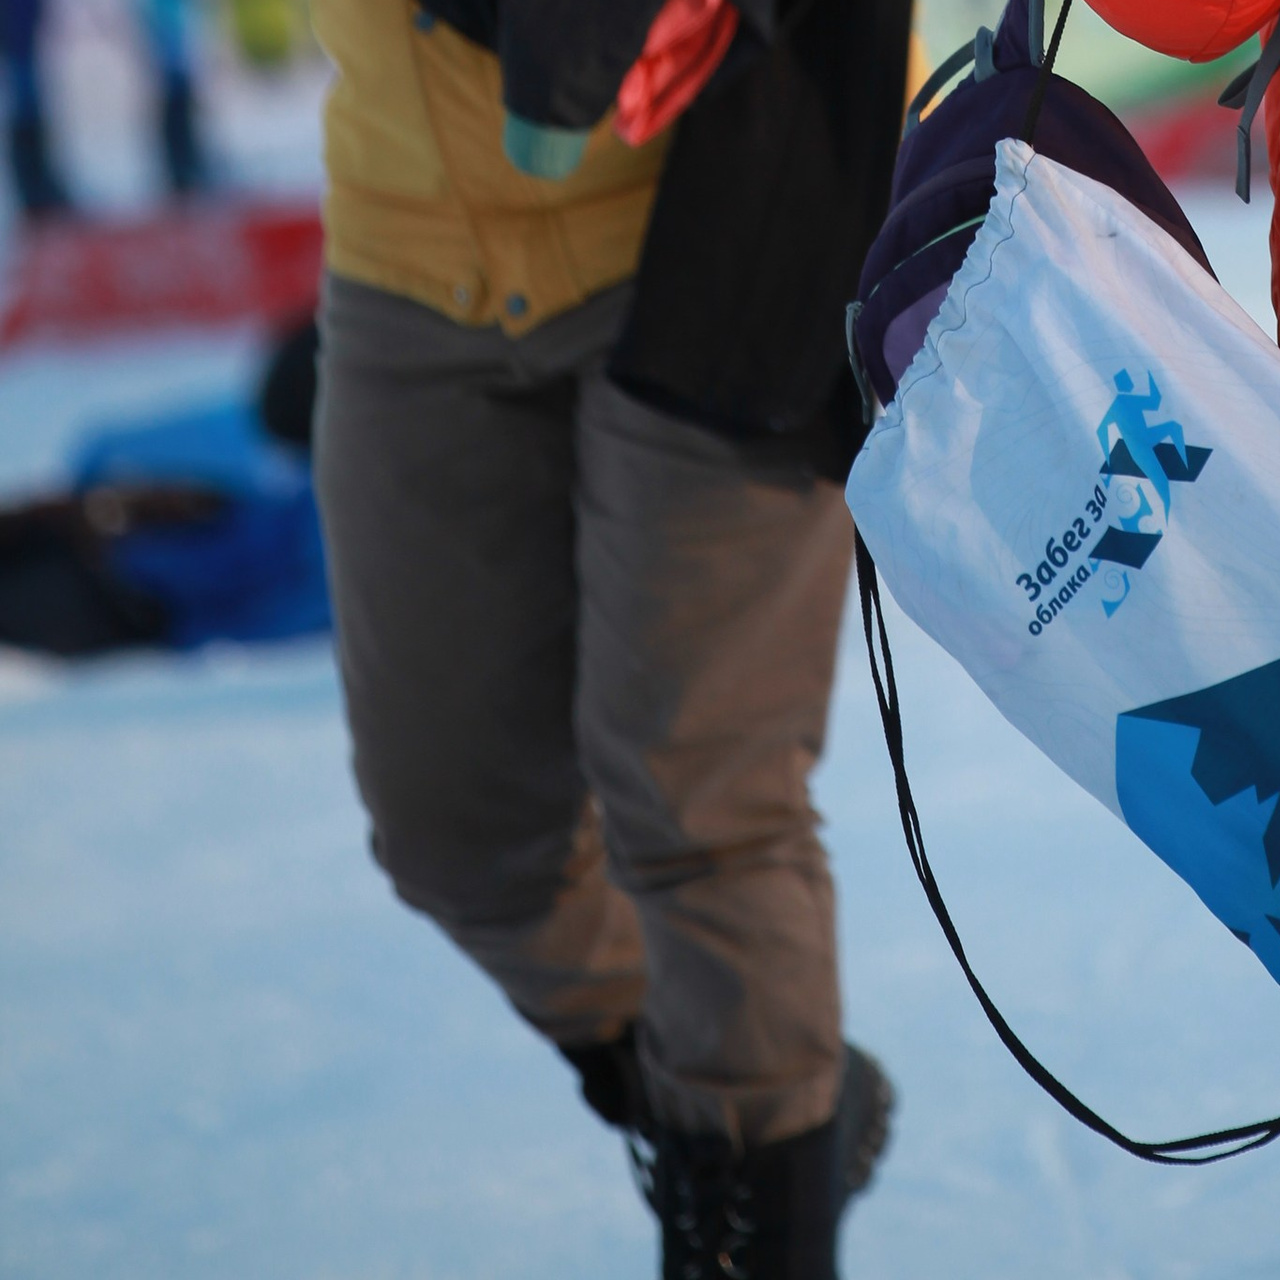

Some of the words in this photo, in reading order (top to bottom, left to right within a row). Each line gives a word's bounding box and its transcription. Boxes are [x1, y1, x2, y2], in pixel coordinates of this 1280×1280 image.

[1015, 517, 1092, 602] Забег
[1085, 484, 1108, 523] за
[1028, 565, 1092, 637] облака
